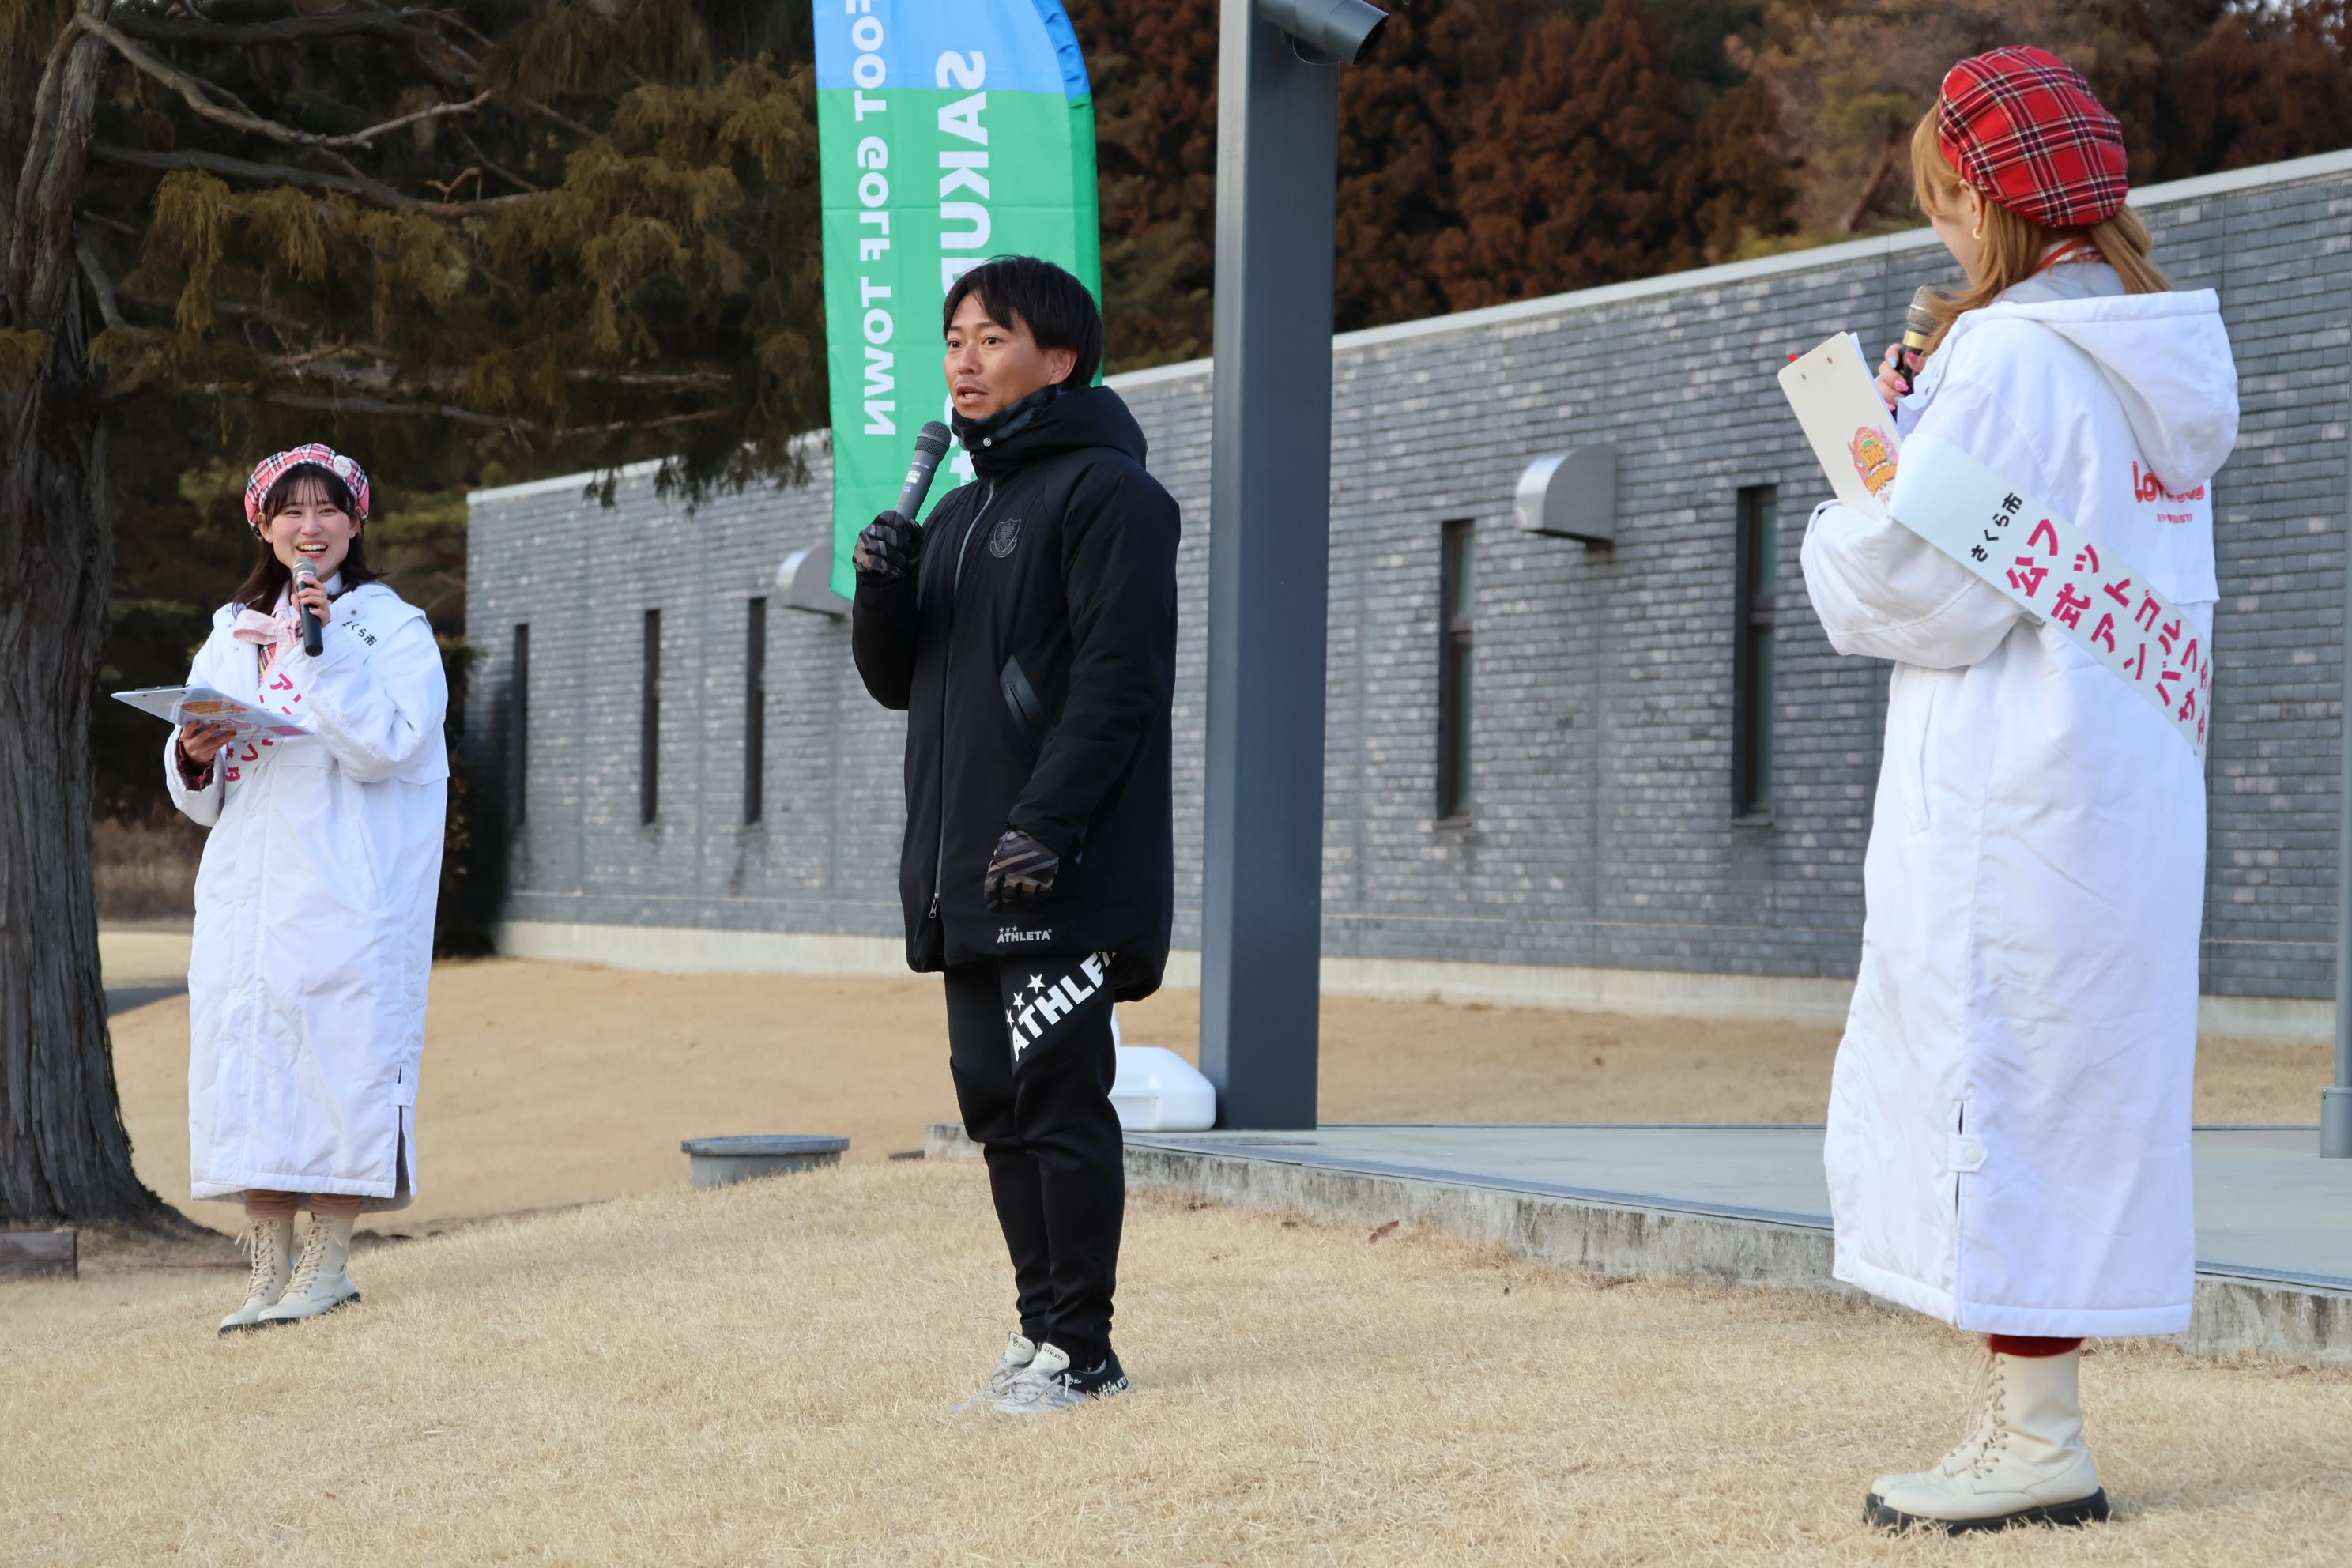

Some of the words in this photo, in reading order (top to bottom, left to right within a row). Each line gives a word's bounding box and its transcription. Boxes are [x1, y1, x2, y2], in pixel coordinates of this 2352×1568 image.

[1971, 492, 2023, 562] さくら市
[2027, 518, 2213, 705] フットゴルフタ
[1012, 951, 1116, 1062] ATHLE
